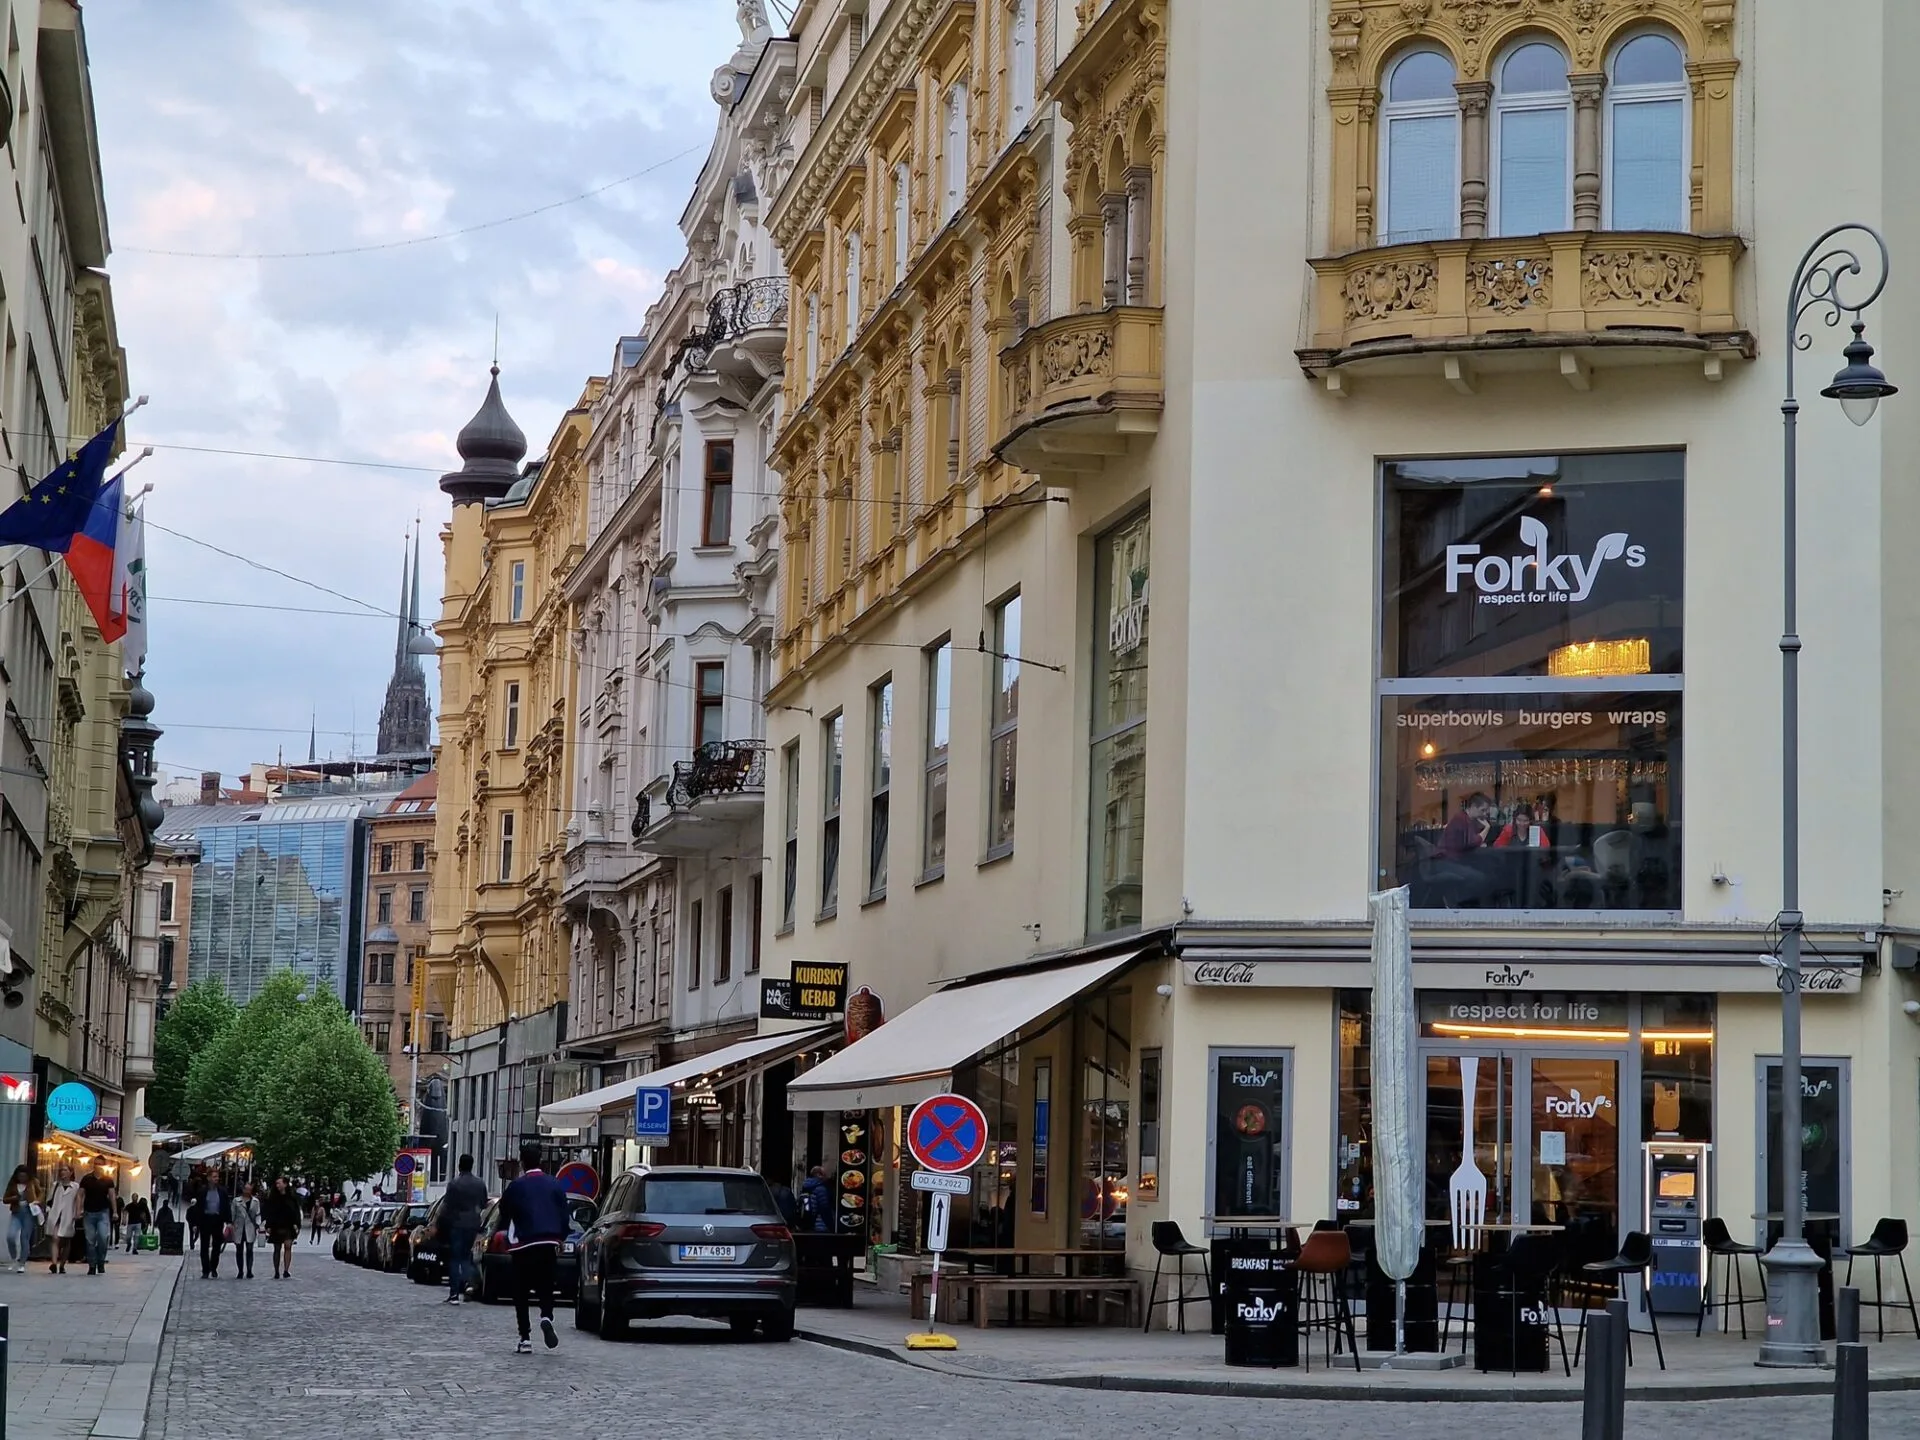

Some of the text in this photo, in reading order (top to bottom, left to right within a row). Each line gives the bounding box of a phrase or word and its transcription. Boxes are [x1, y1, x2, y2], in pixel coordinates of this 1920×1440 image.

[1478, 591, 1568, 605] respect for life
[1397, 708, 1667, 730] superbowls burgers wraps
[796, 966, 844, 985] KURDSKÝ
[801, 989, 836, 1007] KEBAB
[1450, 1002, 1599, 1021] respect for life
[643, 1093, 663, 1119] P
[417, 1251, 437, 1262] Wolt
[687, 1246, 704, 1255] 7AT
[1232, 1258, 1269, 1270] BREAKFAST
[1652, 1272, 1699, 1287] ATM
